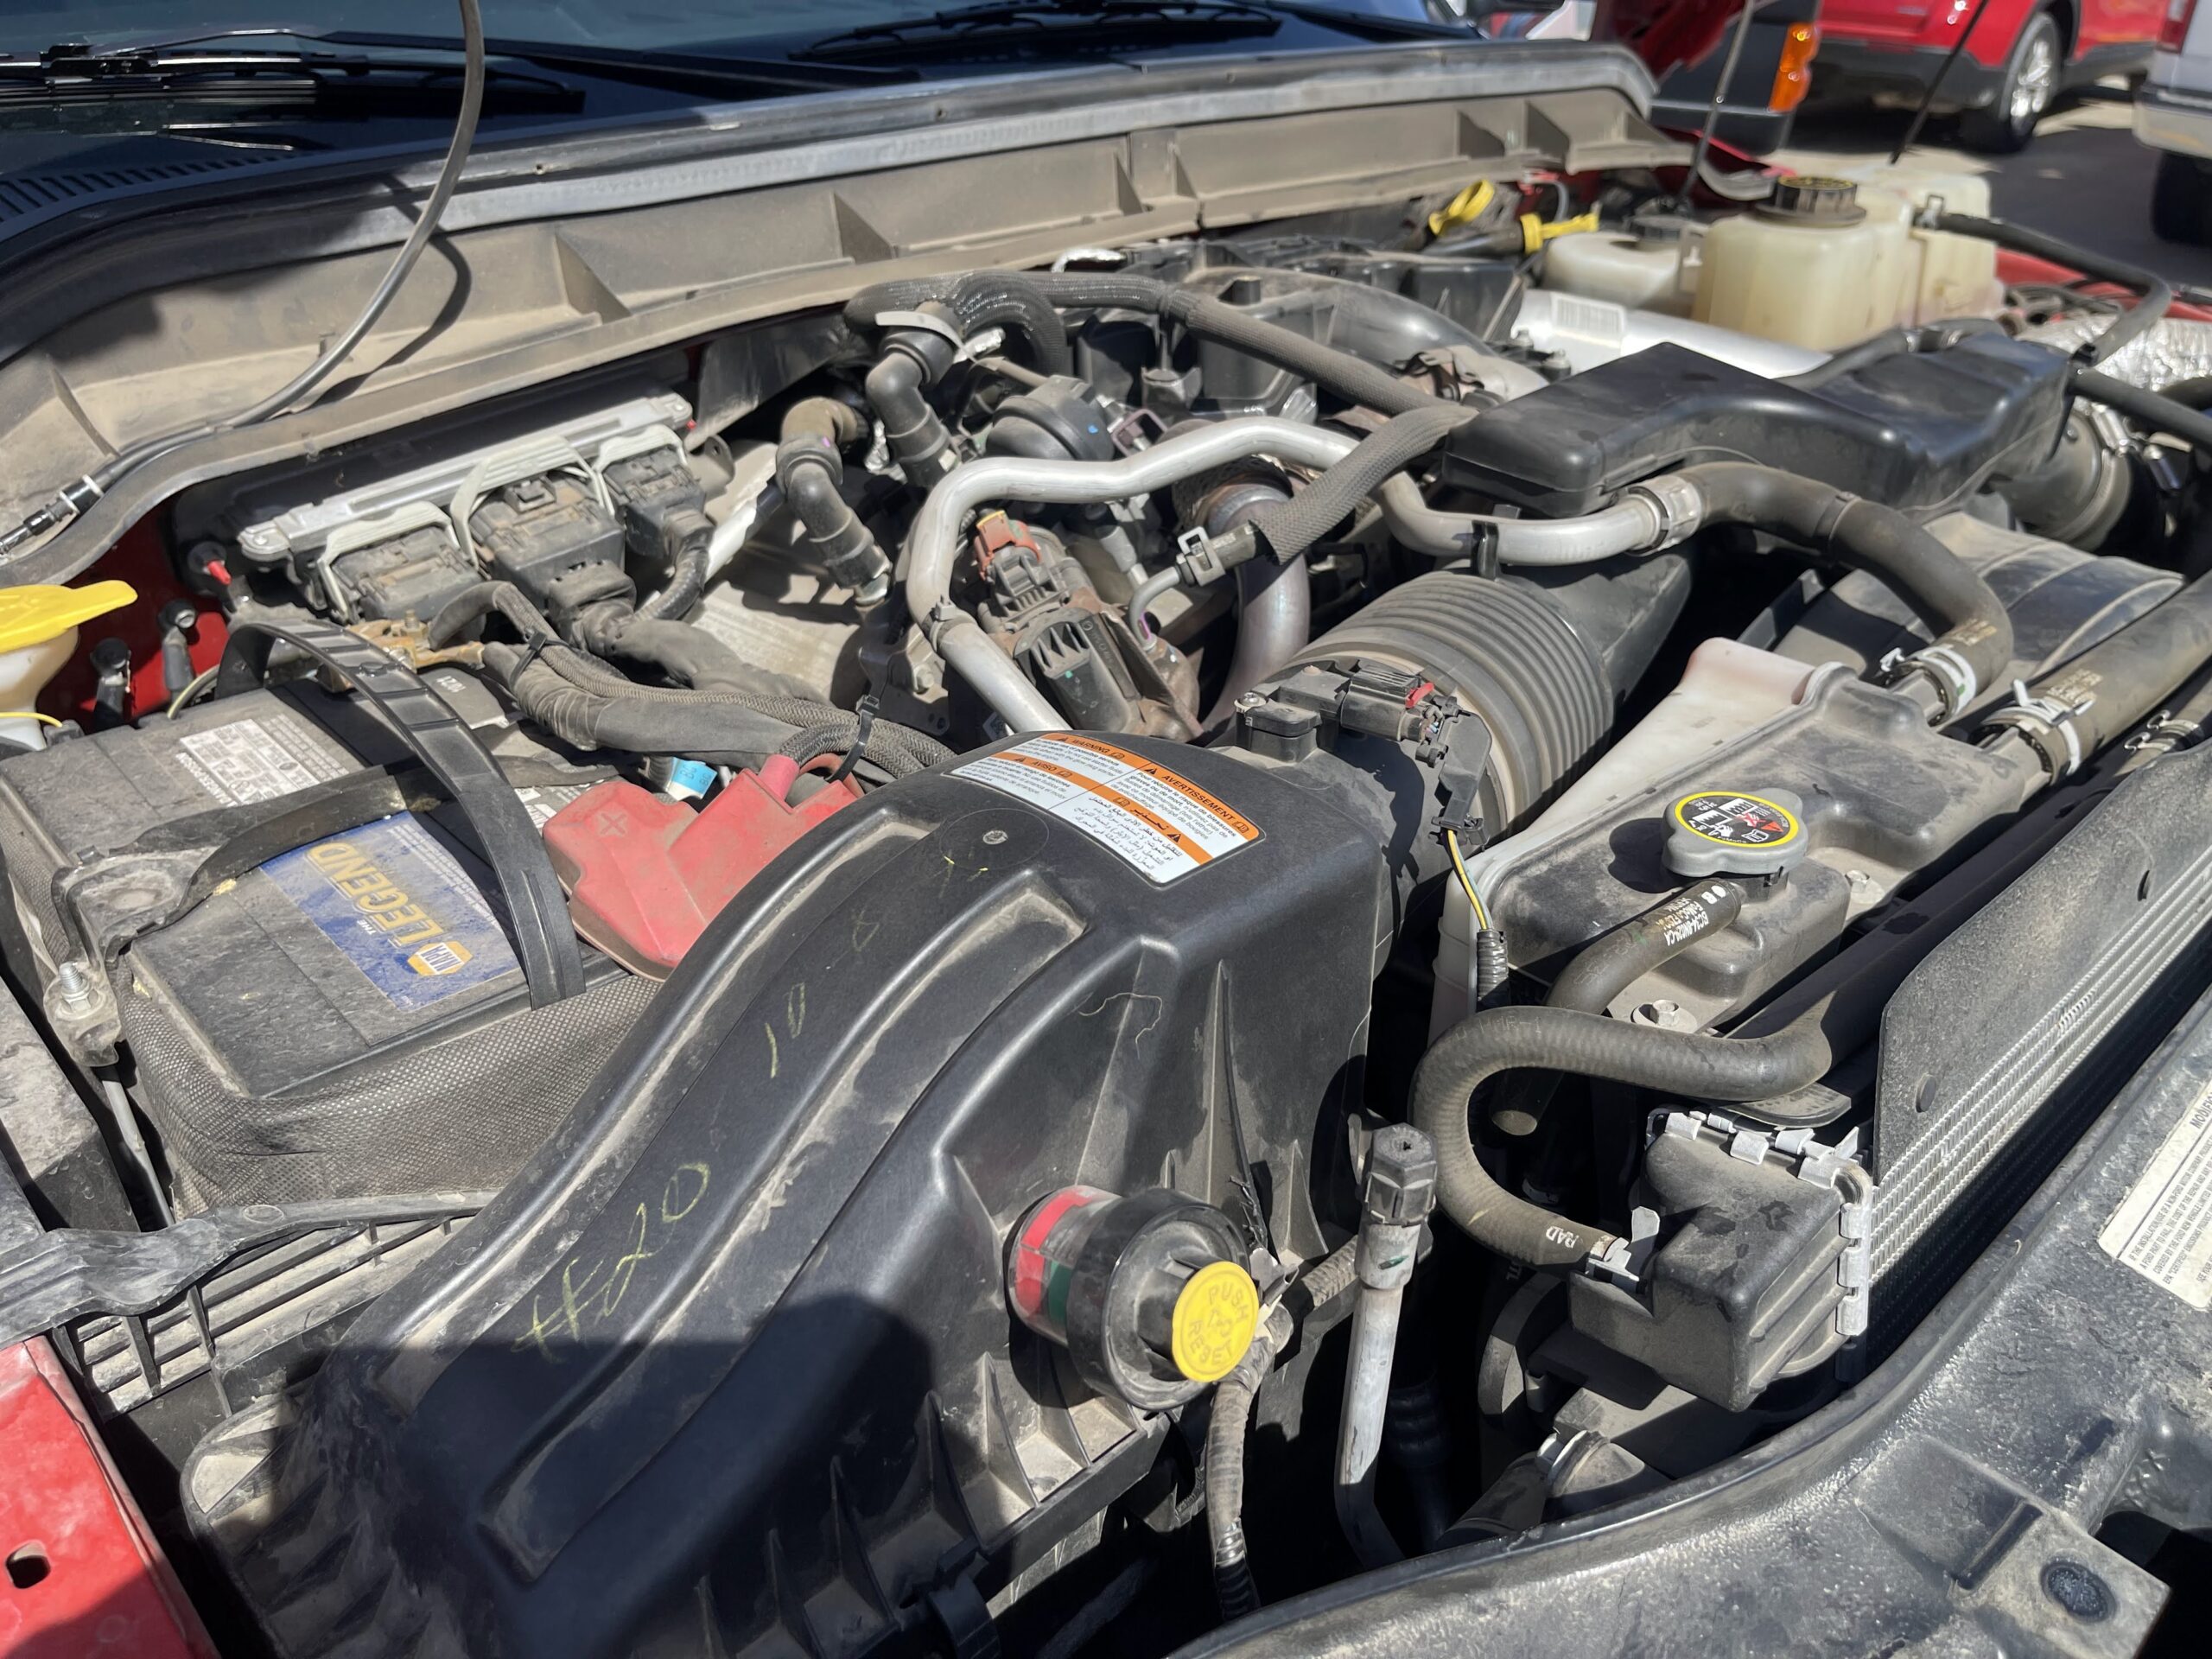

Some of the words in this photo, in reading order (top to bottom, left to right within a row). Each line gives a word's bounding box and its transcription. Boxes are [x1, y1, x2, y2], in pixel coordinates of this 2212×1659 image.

[1072, 740, 1109, 753] WARNING
[1031, 760, 1058, 772] AVISO
[1129, 775, 1150, 786] graves
[1206, 823, 1219, 831] pas
[1136, 772, 1151, 780] Pour
[1179, 796, 1198, 808] risque
[1206, 814, 1238, 836] blessures
[1162, 775, 1236, 821] AVERTISSEMENT
[1138, 791, 1158, 804] moteur
[1185, 822, 1208, 839] bougies
[304, 842, 444, 947] LEGEND
[356, 918, 377, 935] THE
[419, 941, 463, 975] NAPA
[2196, 1174, 2207, 1185] AND
[2201, 1166, 2212, 1177] ANY
[2187, 1182, 2202, 1198] REPAIR
[2196, 1190, 2212, 1207] LIMITED
[2133, 1246, 2144, 1256] THE
[2167, 1185, 2185, 1205] NON-FORD
[2180, 1172, 2194, 1187] MOTOR
[2189, 1156, 2205, 1174] COMPANY
[2183, 1195, 2193, 1205] THE
[2172, 1208, 2184, 1221] COST
[2187, 1205, 2202, 1223] VEHICLE
[2167, 1217, 2177, 1229] THE
[2181, 1220, 2192, 1231] NEW
[1546, 1225, 1580, 1249] RAD
[2174, 1229, 2187, 1243] FORD
[2150, 1242, 2162, 1255] PART
[2169, 1240, 2180, 1250] THE
[2142, 1252, 2155, 1266] FORD
[2153, 1254, 2171, 1274] COVERED
[2163, 1274, 2174, 1285] EPA
[2183, 1229, 2203, 1252] EMISSIONS
[2196, 1272, 2207, 1283] SEE
[1209, 1281, 1249, 1324] PUSH
[1188, 1320, 1234, 1363] RESET
